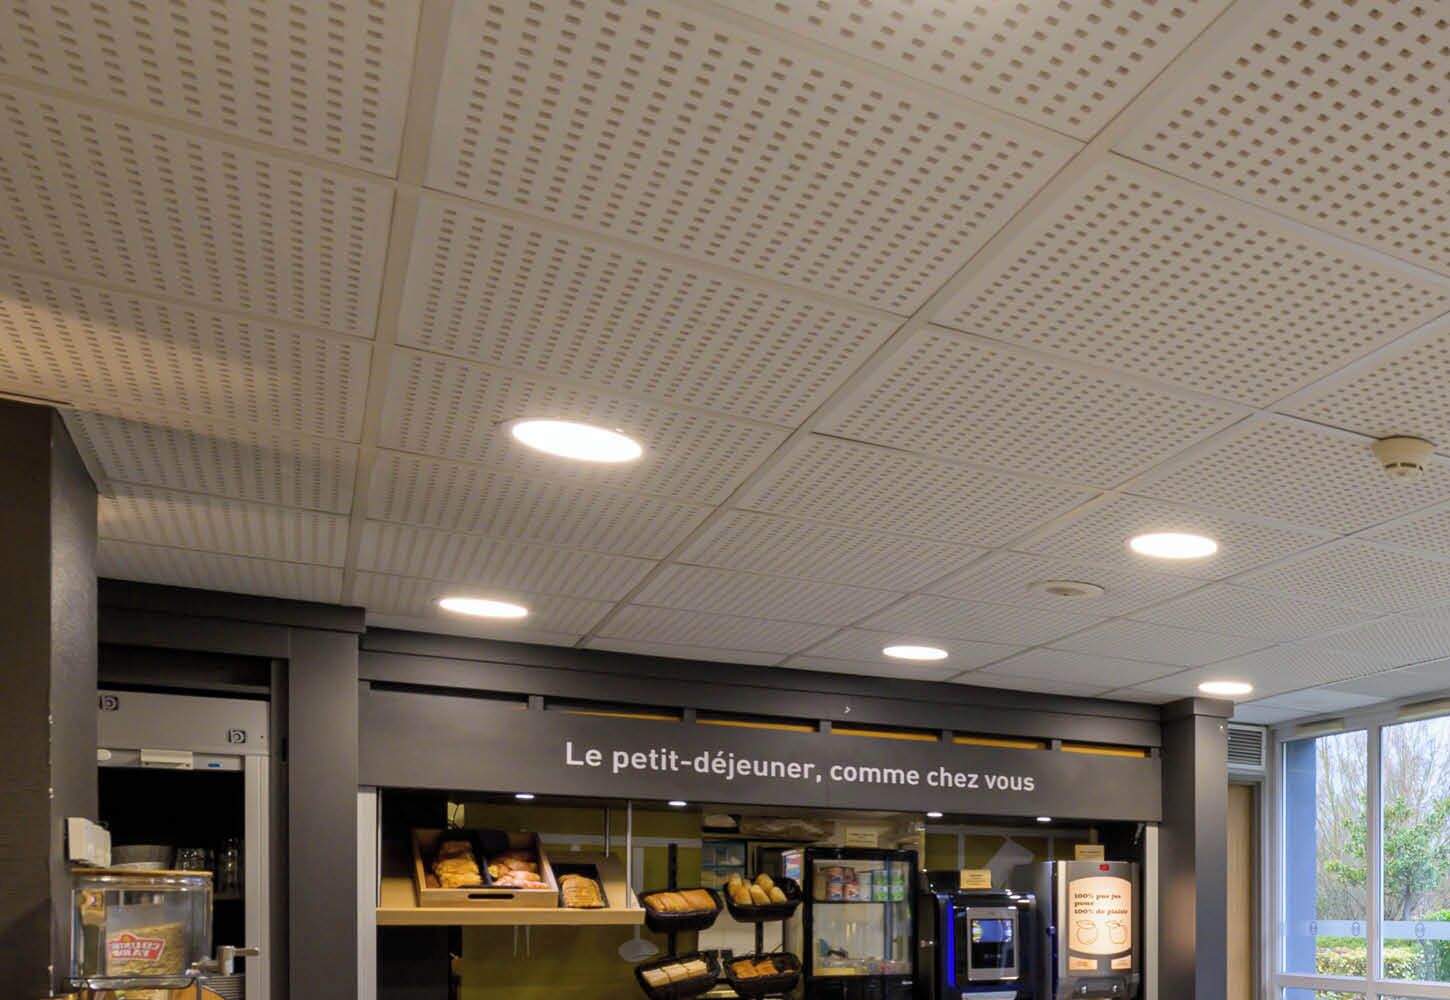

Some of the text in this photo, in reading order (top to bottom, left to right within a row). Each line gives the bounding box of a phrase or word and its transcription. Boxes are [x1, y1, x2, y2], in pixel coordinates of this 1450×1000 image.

[565, 741, 1036, 793] Le petit-déjeuner, comme chez vous
